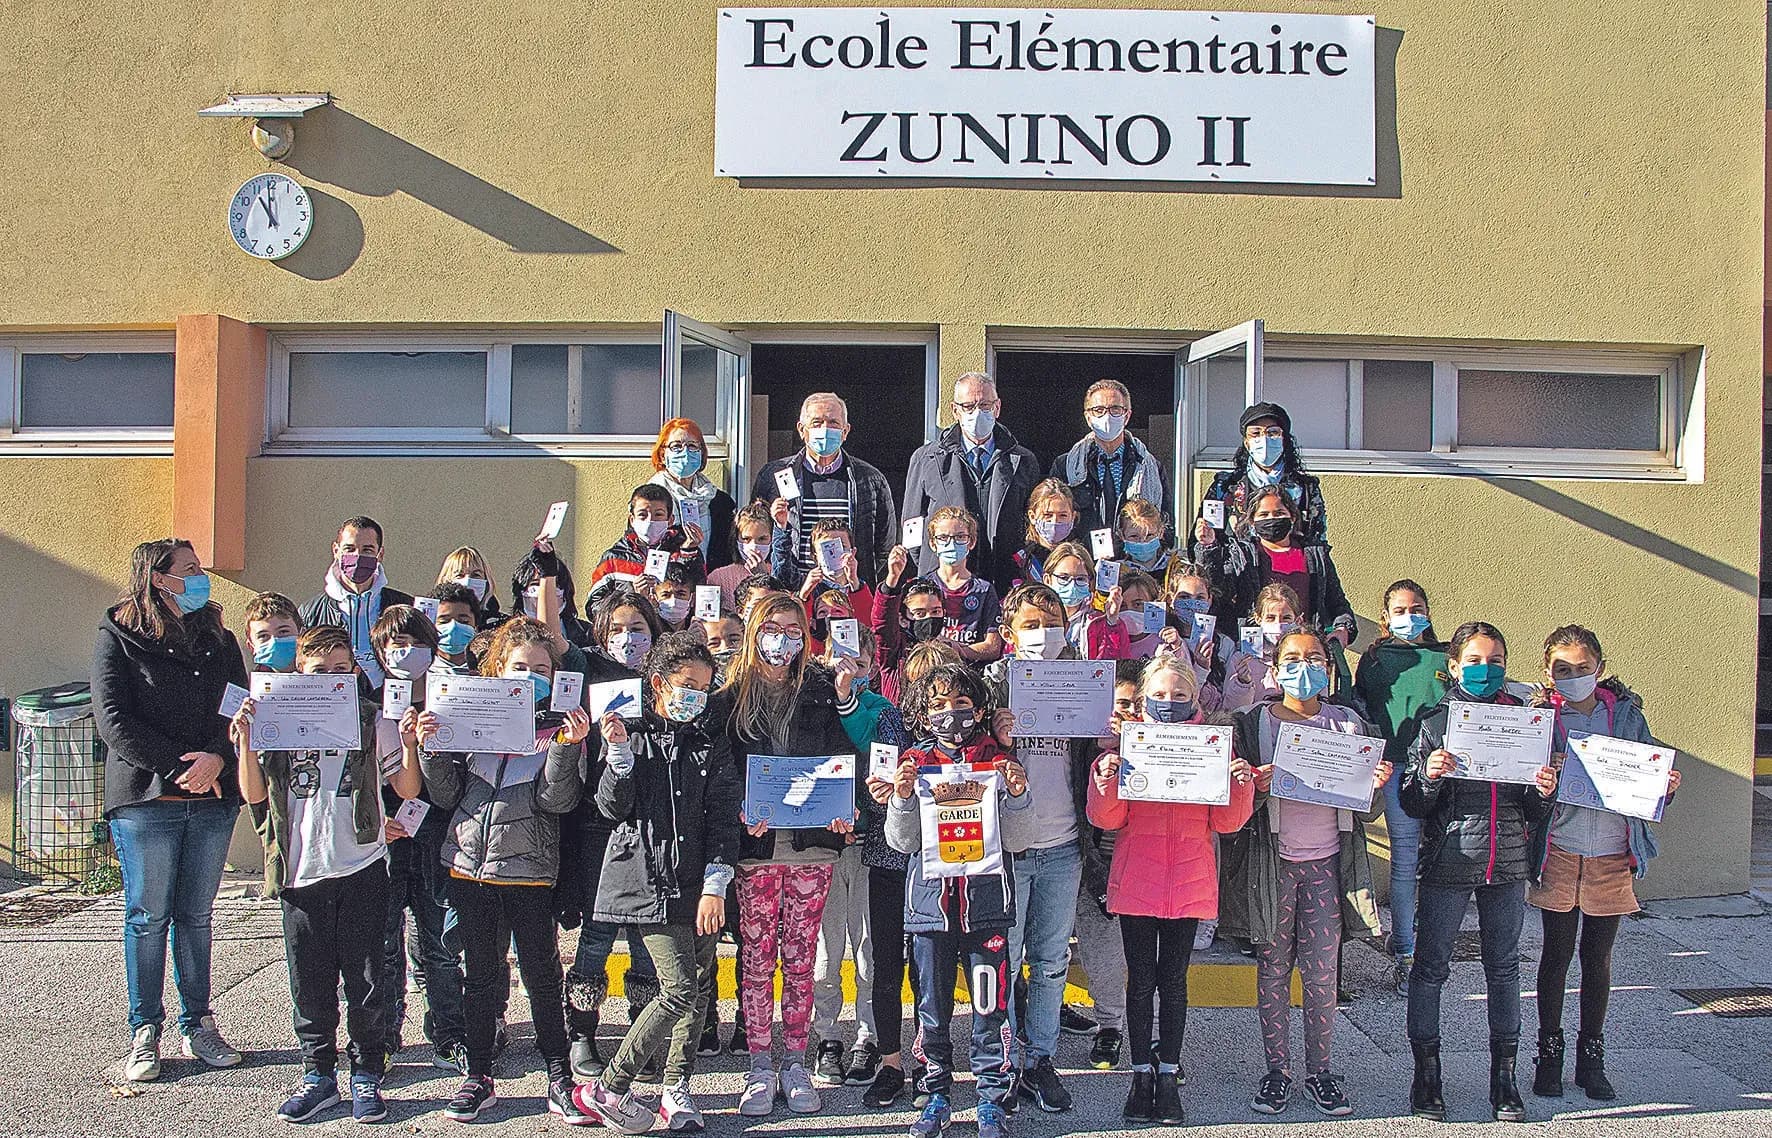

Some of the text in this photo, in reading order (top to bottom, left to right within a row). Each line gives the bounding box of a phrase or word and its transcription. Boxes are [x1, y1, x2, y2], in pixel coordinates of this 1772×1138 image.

[744, 14, 1348, 77] Ecole Elémentaire
[839, 110, 1252, 168] ZUNINO II
[253, 184, 261, 195] 11
[286, 183, 290, 193] 1
[241, 196, 250, 206] 10
[295, 195, 303, 205] 2
[235, 212, 243, 222] 9
[299, 211, 307, 221] 3
[240, 228, 246, 239] 8
[293, 227, 301, 237] 4
[251, 239, 258, 250] 7
[266, 244, 274, 254] 6
[283, 239, 290, 249] 5
[939, 809, 979, 821] GARDE
[949, 845, 974, 853] D T
